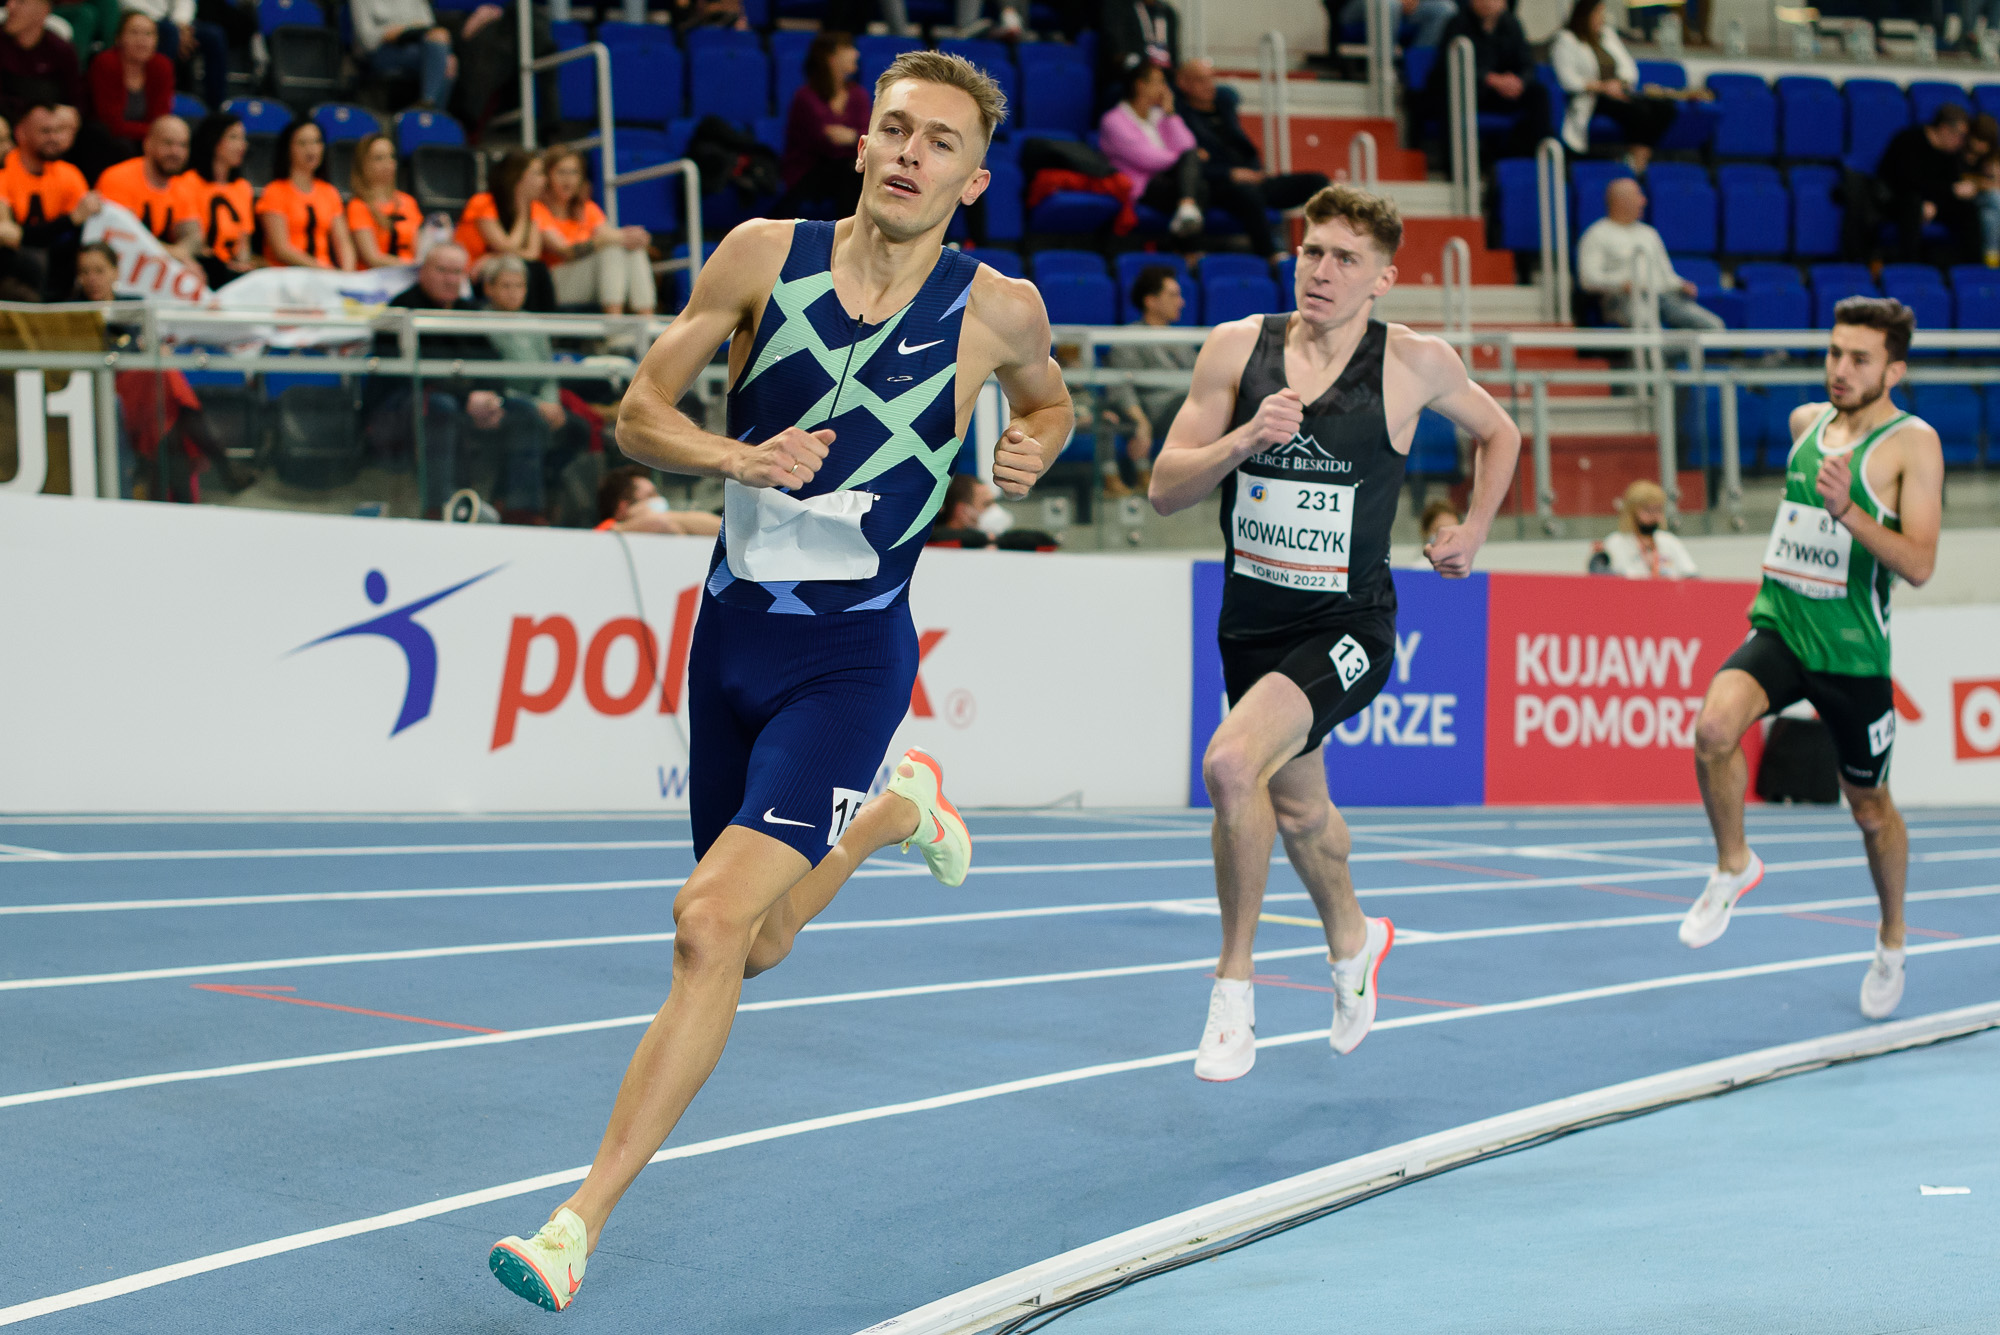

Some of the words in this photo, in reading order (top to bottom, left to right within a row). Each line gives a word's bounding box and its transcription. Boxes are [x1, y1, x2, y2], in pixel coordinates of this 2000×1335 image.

[1293, 456, 1352, 473] BESKIDU
[1297, 489, 1340, 512] 231
[1238, 516, 1345, 553] KOWALCZYK
[1252, 564, 1289, 583] TORUŃ
[1294, 575, 1326, 587] 2022
[1338, 642, 1364, 682] 13
[1516, 633, 1702, 689] KUJAWY
[1515, 694, 1706, 748] POMORZ
